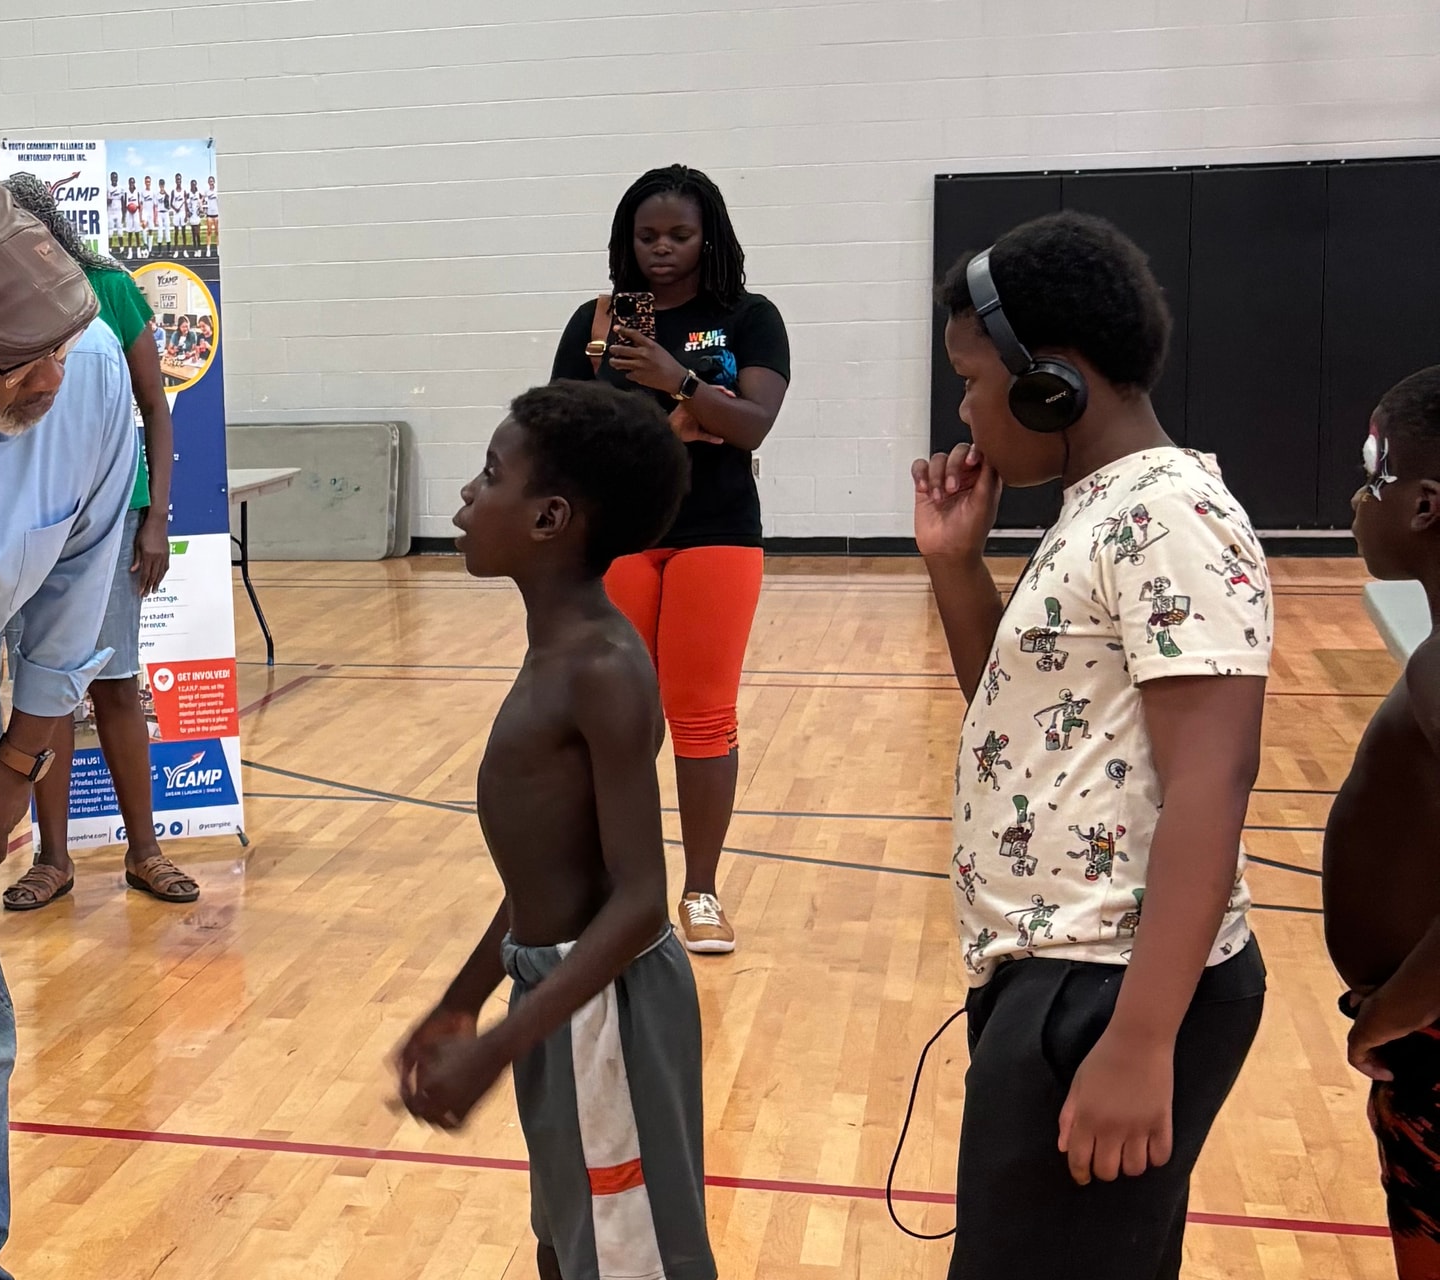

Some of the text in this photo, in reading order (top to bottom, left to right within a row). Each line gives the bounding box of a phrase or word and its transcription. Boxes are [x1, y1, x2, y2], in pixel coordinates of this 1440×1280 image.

[684, 334, 727, 351] ST. PETE
[688, 331, 705, 342] WE
[177, 669, 231, 681] GET INVOLVED!
[72, 756, 100, 766] OIN US!
[163, 760, 222, 789] YCAMP
